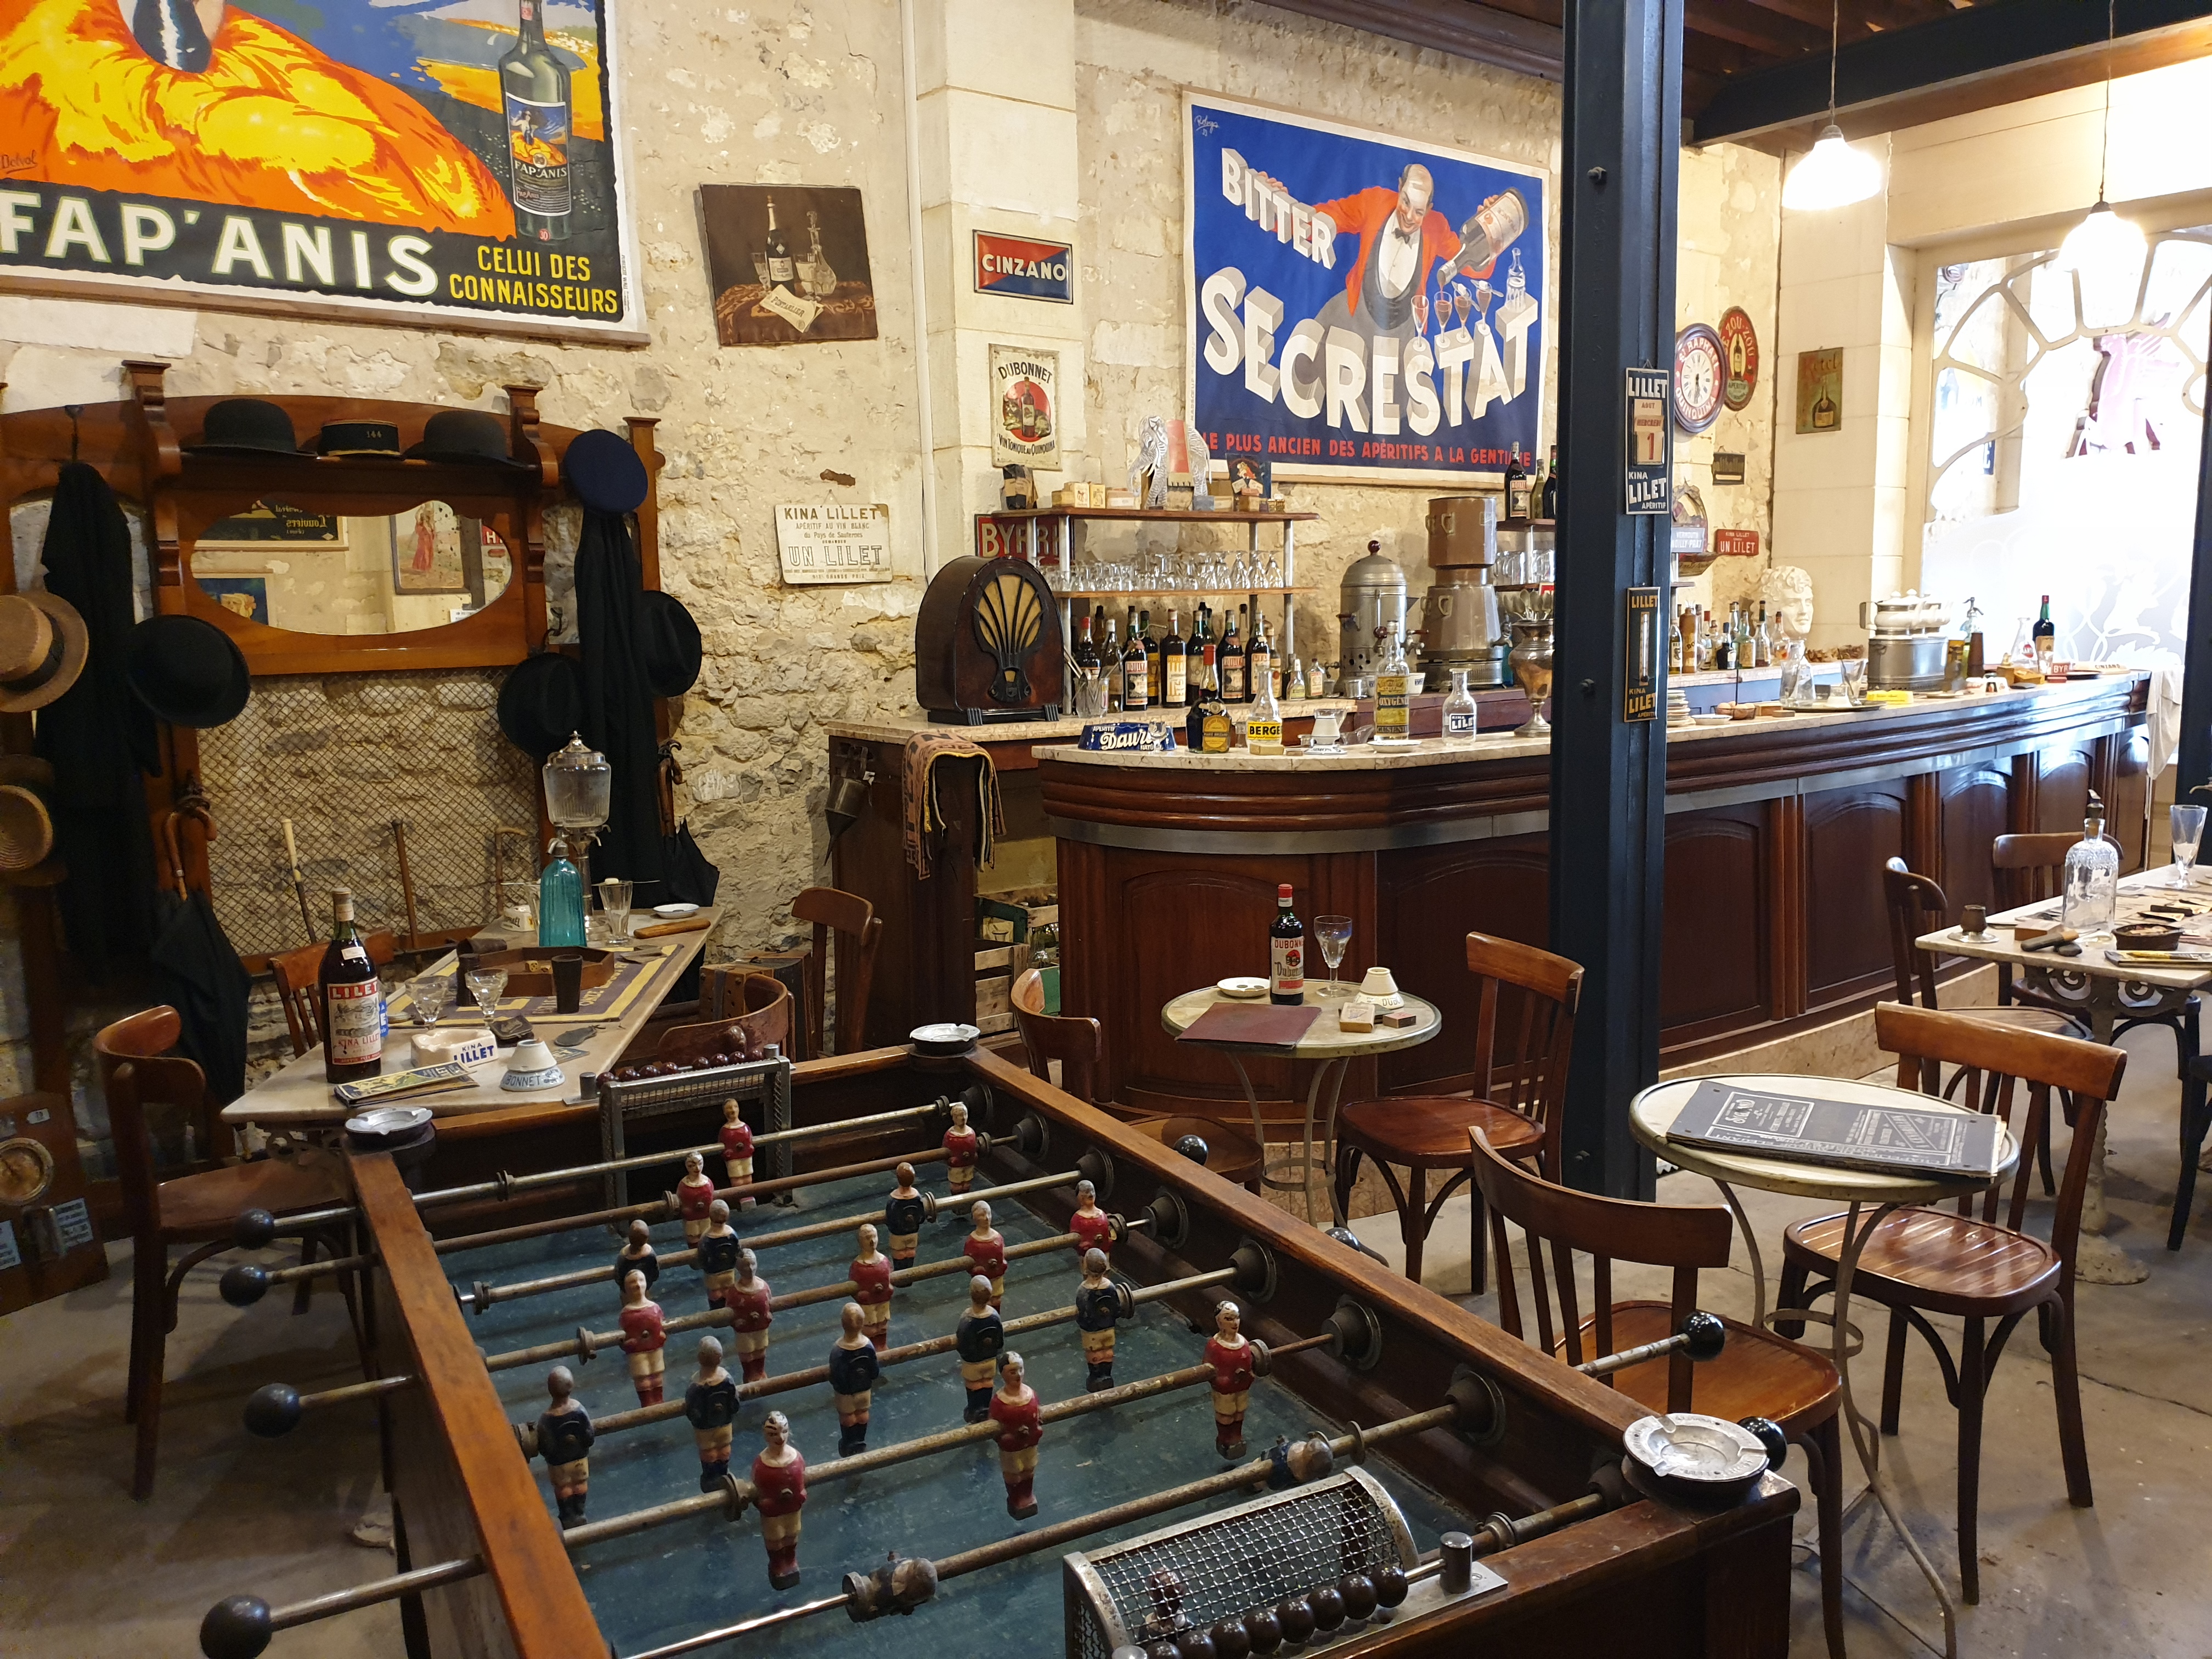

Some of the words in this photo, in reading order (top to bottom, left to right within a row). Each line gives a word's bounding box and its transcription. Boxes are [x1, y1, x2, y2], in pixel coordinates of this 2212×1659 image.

[515, 160, 567, 178] FAP'ANIS
[1222, 148, 1336, 269] BITTER
[0, 188, 439, 298] FAP'ANIS
[478, 245, 540, 276] CELUI
[550, 253, 591, 281] DES
[982, 253, 1067, 282] CINZANO
[449, 274, 618, 314] CONNAISSEURS
[1201, 266, 1538, 437] SECRESTAT
[997, 362, 1053, 384] DUBONNET
[1628, 376, 1667, 398] LILLET
[1226, 433, 1262, 452] PLUS
[1268, 436, 1321, 456] ANCIEN
[1329, 438, 1355, 458] DES
[1362, 438, 1429, 461] APÉRITIFS
[1434, 444, 1444, 461] A
[1449, 446, 1465, 463] LA
[1647, 432, 1655, 460] 1
[1628, 471, 1648, 480] KINA
[1628, 477, 1667, 504] LILET
[784, 508, 819, 520] KINA
[827, 508, 879, 520] LILLET
[796, 522, 822, 531] APÉRITIF
[788, 546, 814, 566] UN
[824, 545, 882, 566] LILET
[1720, 541, 1730, 552] UN
[1733, 541, 1755, 553] LILET
[1632, 595, 1658, 608] LILLET
[1629, 692, 1656, 714] LILET
[332, 981, 377, 998] LILET
[462, 1042, 482, 1052] KINA
